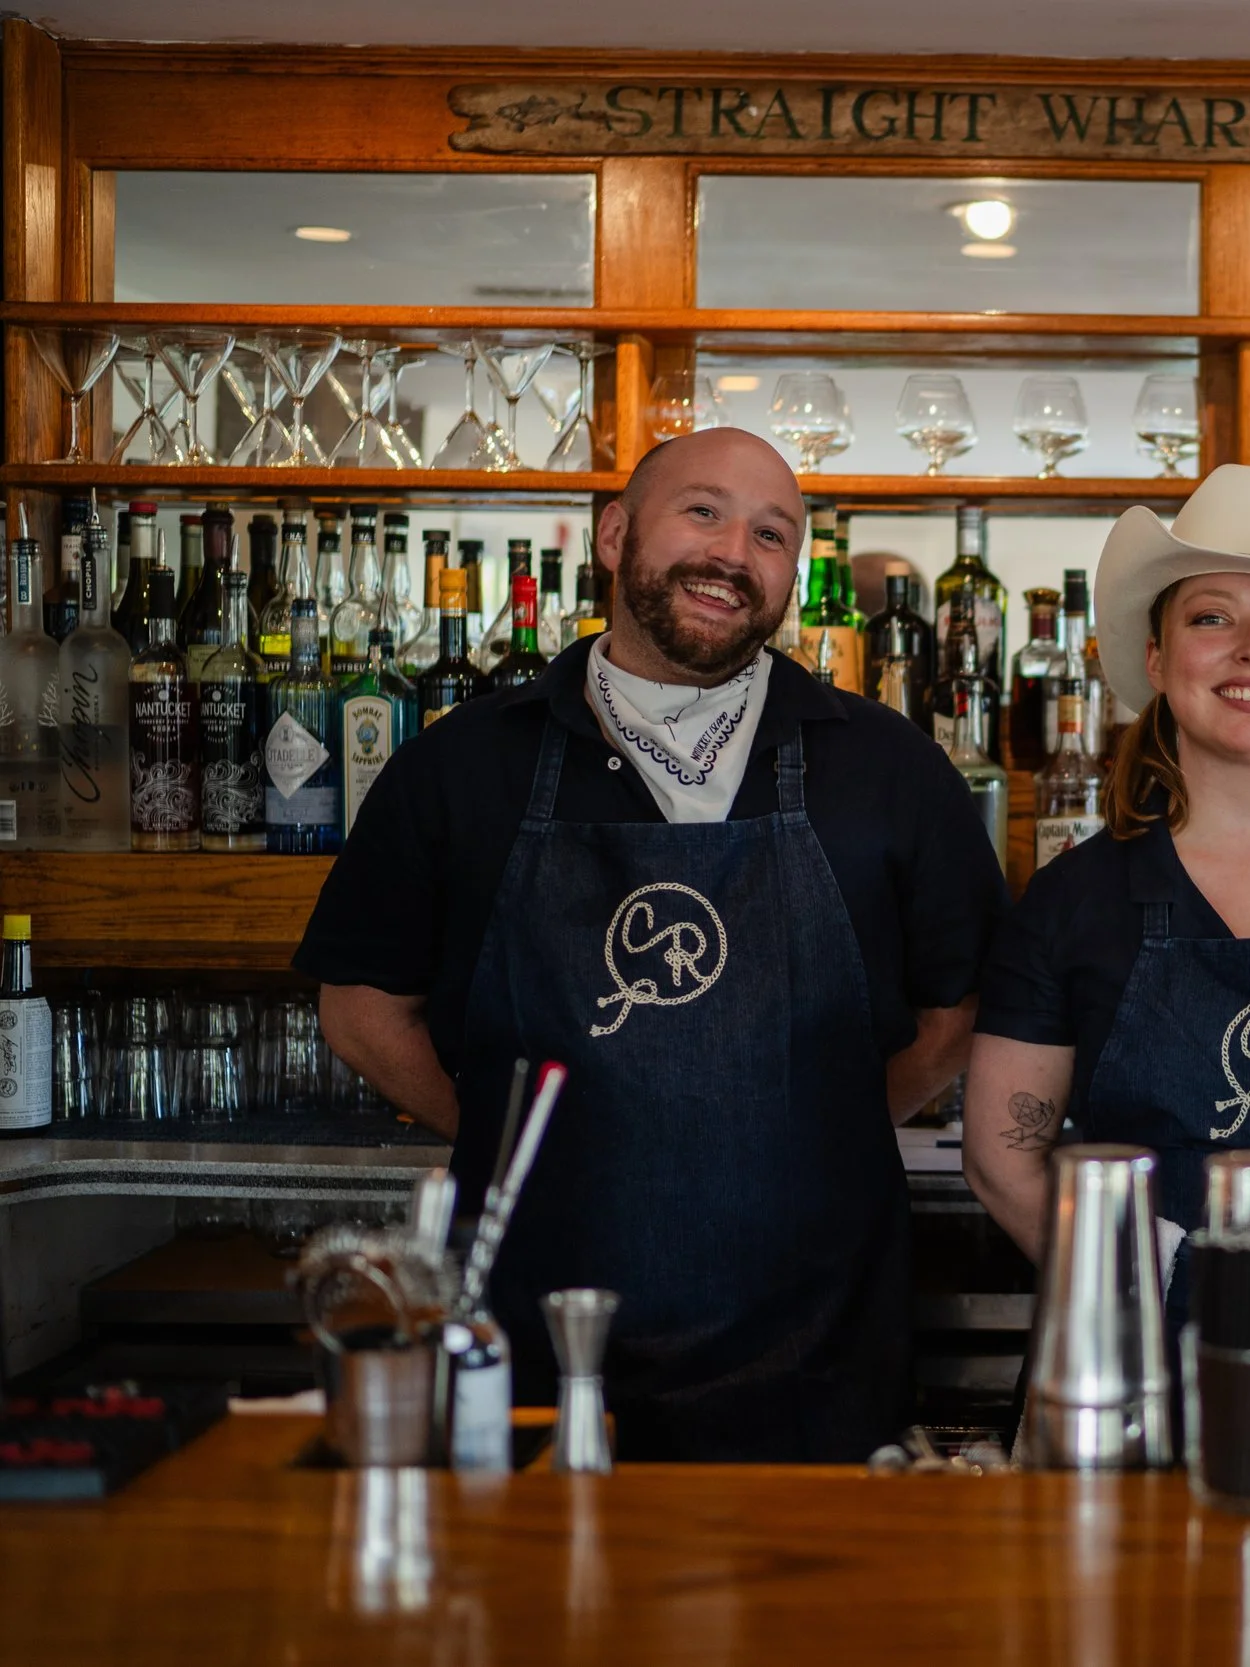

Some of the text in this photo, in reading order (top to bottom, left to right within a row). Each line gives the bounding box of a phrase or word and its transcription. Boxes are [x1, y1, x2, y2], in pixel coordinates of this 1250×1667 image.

[604, 85, 997, 143] STRAIGHT
[135, 701, 192, 719] NANTUCKET
[200, 701, 246, 720] ANTUCKET
[352, 705, 383, 722] BOMBAY
[61, 663, 112, 803] Chopin
[709, 711, 728, 736] ISLAND
[352, 752, 385, 766] SAPPHIRE
[1038, 821, 1070, 841] Captain
